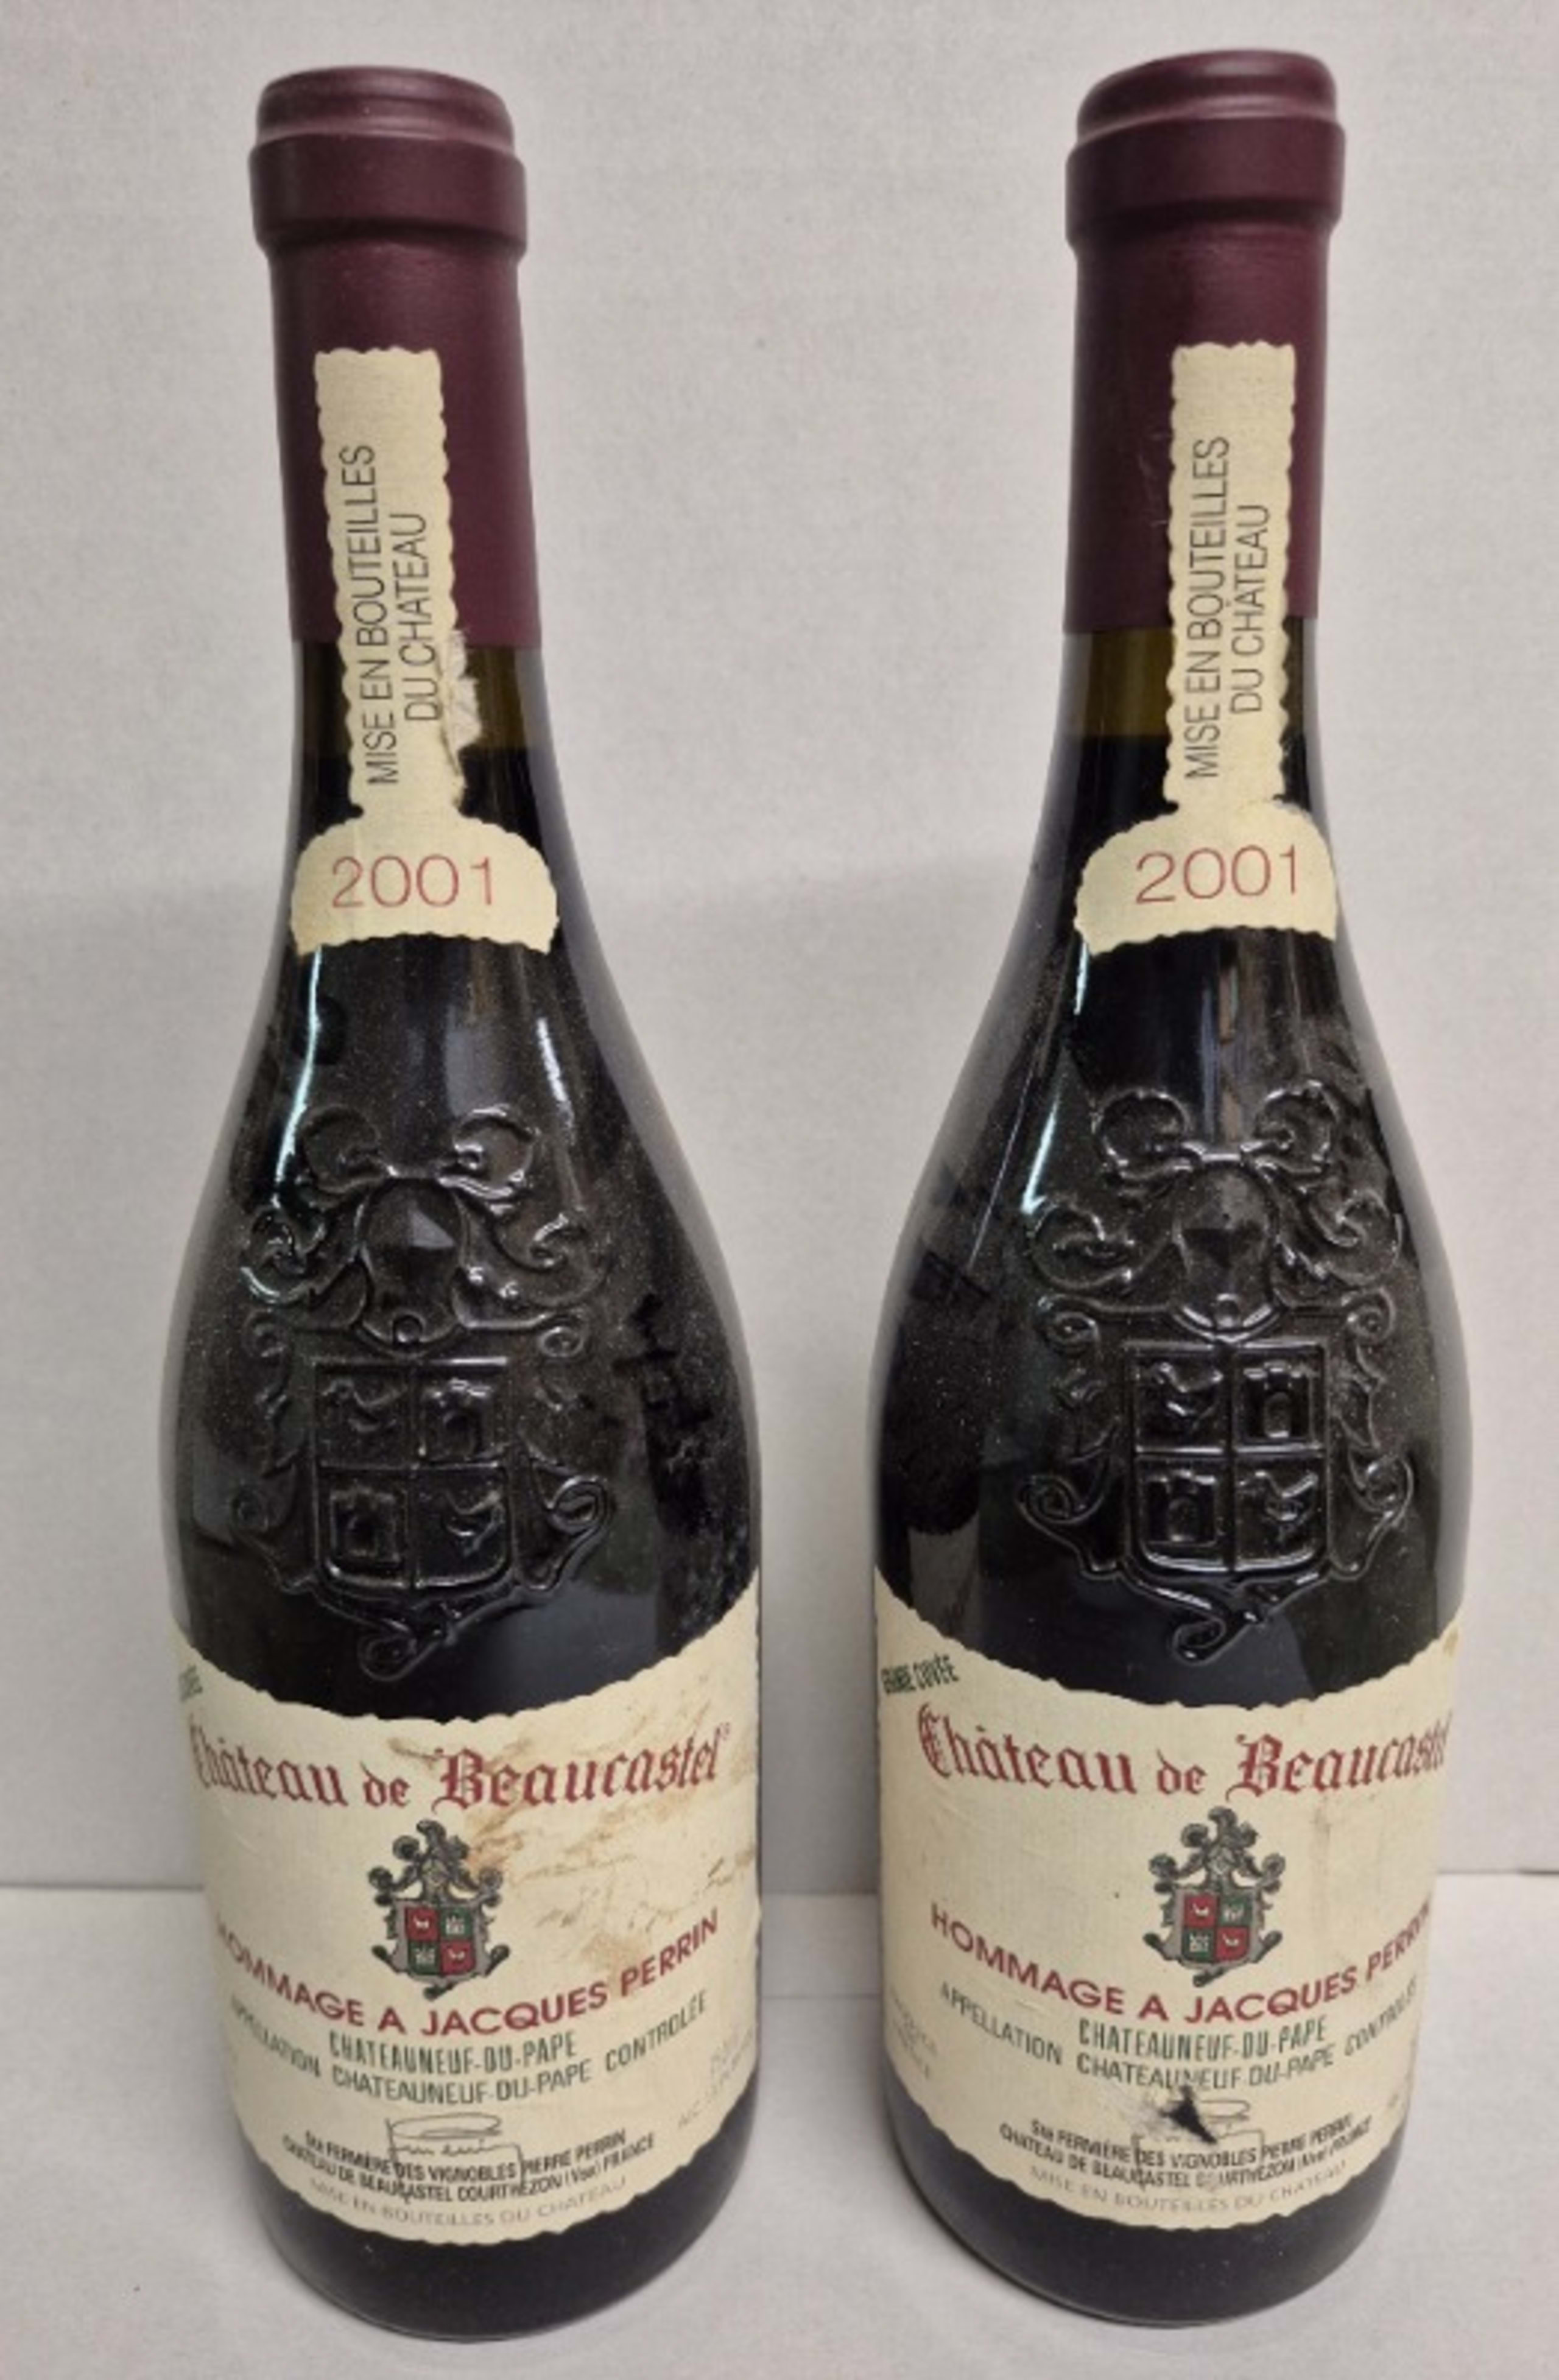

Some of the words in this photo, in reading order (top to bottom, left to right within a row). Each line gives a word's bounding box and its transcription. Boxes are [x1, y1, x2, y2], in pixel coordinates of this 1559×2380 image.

[339, 445, 389, 646] BOUTEILLES
[1187, 436, 1230, 639] BOUTEILLES
[359, 659, 393, 701] EN
[404, 678, 442, 722] DU
[1185, 650, 1221, 693] EN
[1229, 669, 1264, 714] DU
[363, 712, 399, 784] MISE
[1184, 704, 1220, 778] MISE
[331, 854, 495, 908] 2001
[1135, 844, 1299, 905] 2001
[360, 1761, 411, 1807] de
[917, 1703, 1138, 1795] Château
[1156, 1748, 1207, 1795] de
[1226, 1709, 1452, 1803] Beaucast
[378, 2007, 407, 2035] A
[420, 1981, 608, 2036] JACQUES
[620, 1906, 719, 1997] PERRIN
[931, 1903, 1125, 2015] HOMMAGE
[1138, 1994, 1169, 2021] A
[1184, 1965, 1357, 2024] JACQUES
[1365, 1895, 1432, 1982] PERR
[231, 1994, 320, 2077] LLATION
[940, 1981, 1062, 2066] APPELLATION
[428, 2161, 516, 2183] VIGNOBLES
[1170, 2147, 1257, 2171] VIGNOBLES
